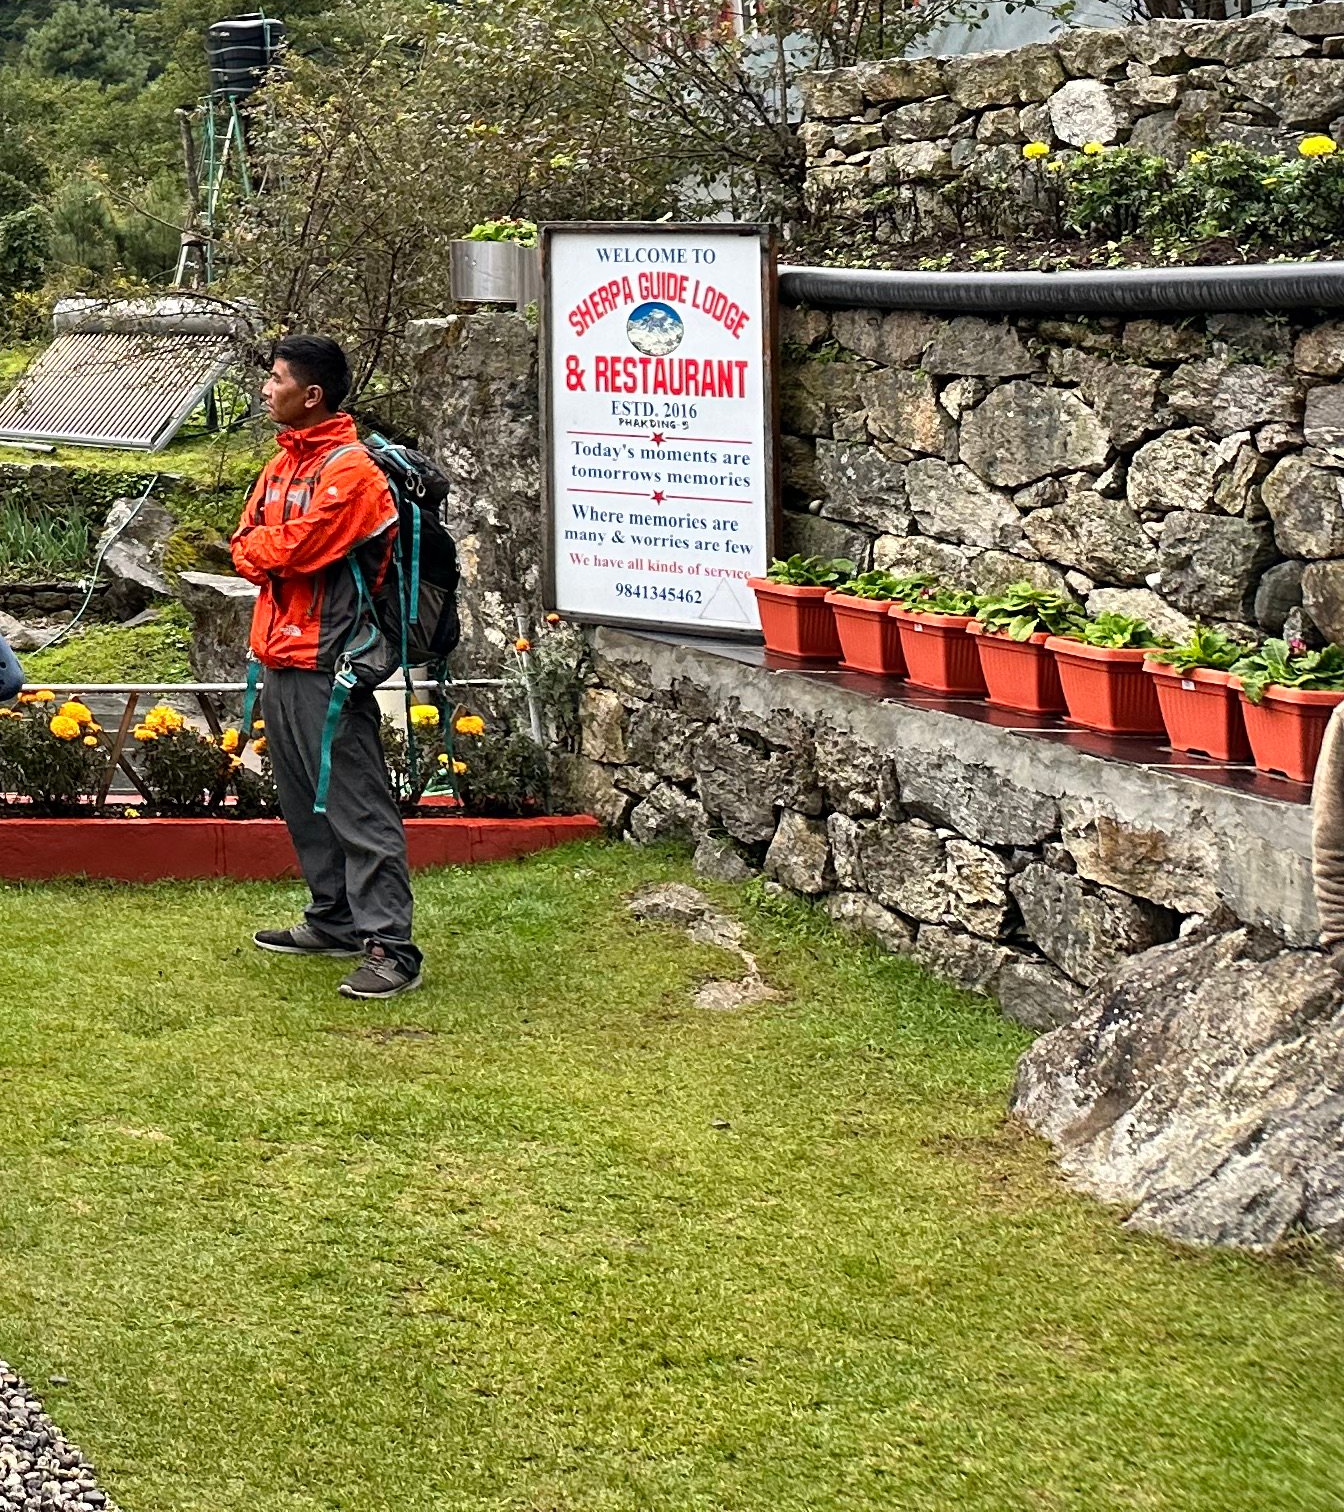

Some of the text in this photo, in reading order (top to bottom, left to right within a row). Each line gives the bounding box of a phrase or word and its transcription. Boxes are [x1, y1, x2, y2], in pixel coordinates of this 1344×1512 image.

[596, 247, 716, 265] WELCOME TO
[568, 271, 750, 340] SHERPA GUIDE LODGE
[566, 355, 748, 398] & RESTAURANT
[611, 400, 698, 419] ESTD. 2016
[571, 440, 751, 466] Today's moments are
[571, 464, 751, 488] tomorrows memories
[571, 503, 739, 532] Where memories are
[564, 529, 753, 555] many & worries are few
[569, 552, 752, 581] We have all kinds of service
[615, 582, 703, 604] 9841345462
